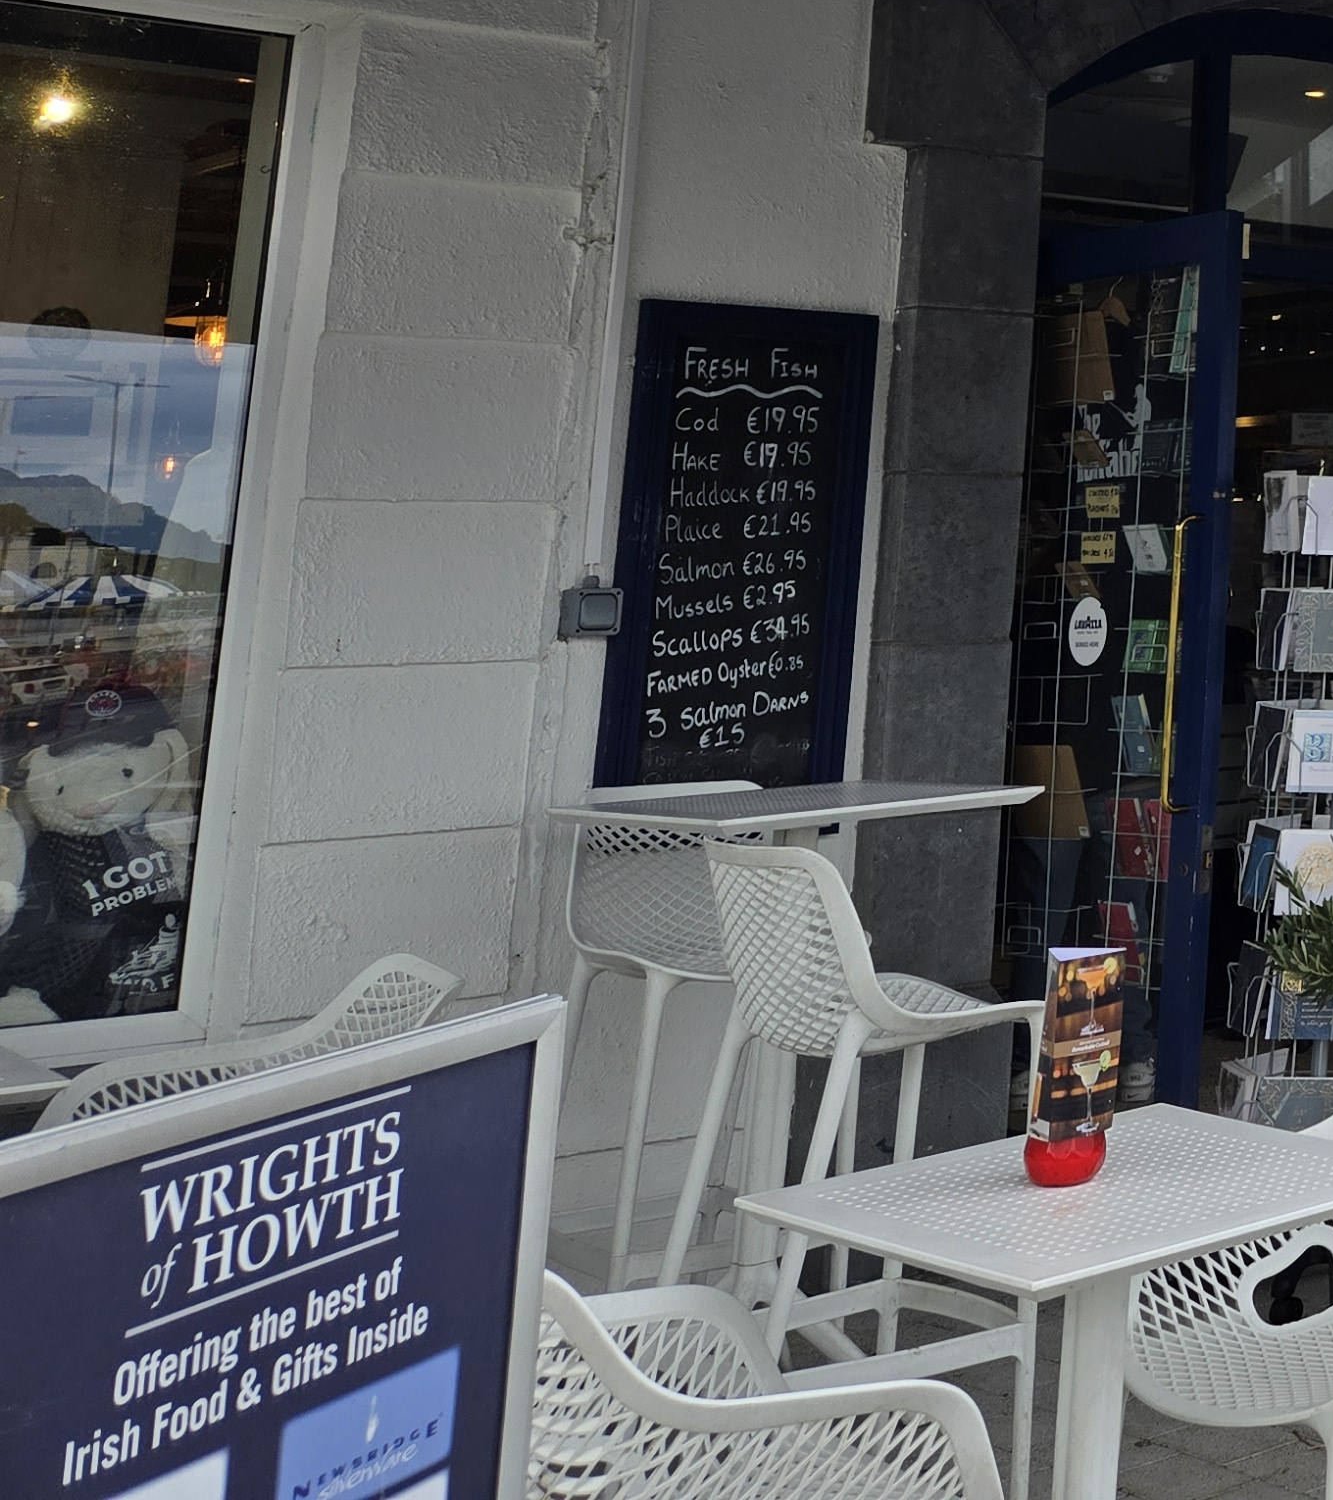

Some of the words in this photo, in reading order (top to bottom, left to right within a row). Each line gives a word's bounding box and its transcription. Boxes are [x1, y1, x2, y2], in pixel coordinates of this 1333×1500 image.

[685, 346, 749, 380] FRESH
[771, 347, 818, 379] FISH
[675, 406, 719, 432] Cod
[747, 405, 820, 434] €19.95
[672, 442, 721, 472] HAKE
[670, 476, 750, 508] Haddock
[756, 480, 816, 505] €19.95
[665, 514, 723, 544] Plaice
[743, 511, 812, 539] €21.95
[658, 553, 735, 585] Salmon
[742, 550, 807, 576] €26.95
[655, 594, 734, 621] Mussels
[743, 580, 796, 610] €2.95
[652, 627, 743, 657] Scallops
[750, 613, 810, 644] €34.95
[646, 666, 713, 697] FARMED
[717, 658, 768, 689] Oyster
[645, 708, 667, 738] 3
[699, 722, 745, 748] €15
[82, 879, 100, 899] I
[103, 851, 170, 889] GOT
[141, 1111, 402, 1243] WRIGHTS
[141, 1243, 183, 1309] of
[187, 1169, 404, 1294] HOWTH
[114, 1323, 241, 1407] Offering
[249, 1306, 297, 1357] the
[305, 1272, 368, 1330] best
[375, 1255, 403, 1296] of
[62, 1418, 141, 1487] Irish
[152, 1377, 227, 1450] Food
[236, 1374, 261, 1413] &
[271, 1343, 338, 1397] Gifts
[346, 1303, 429, 1367] Inside
